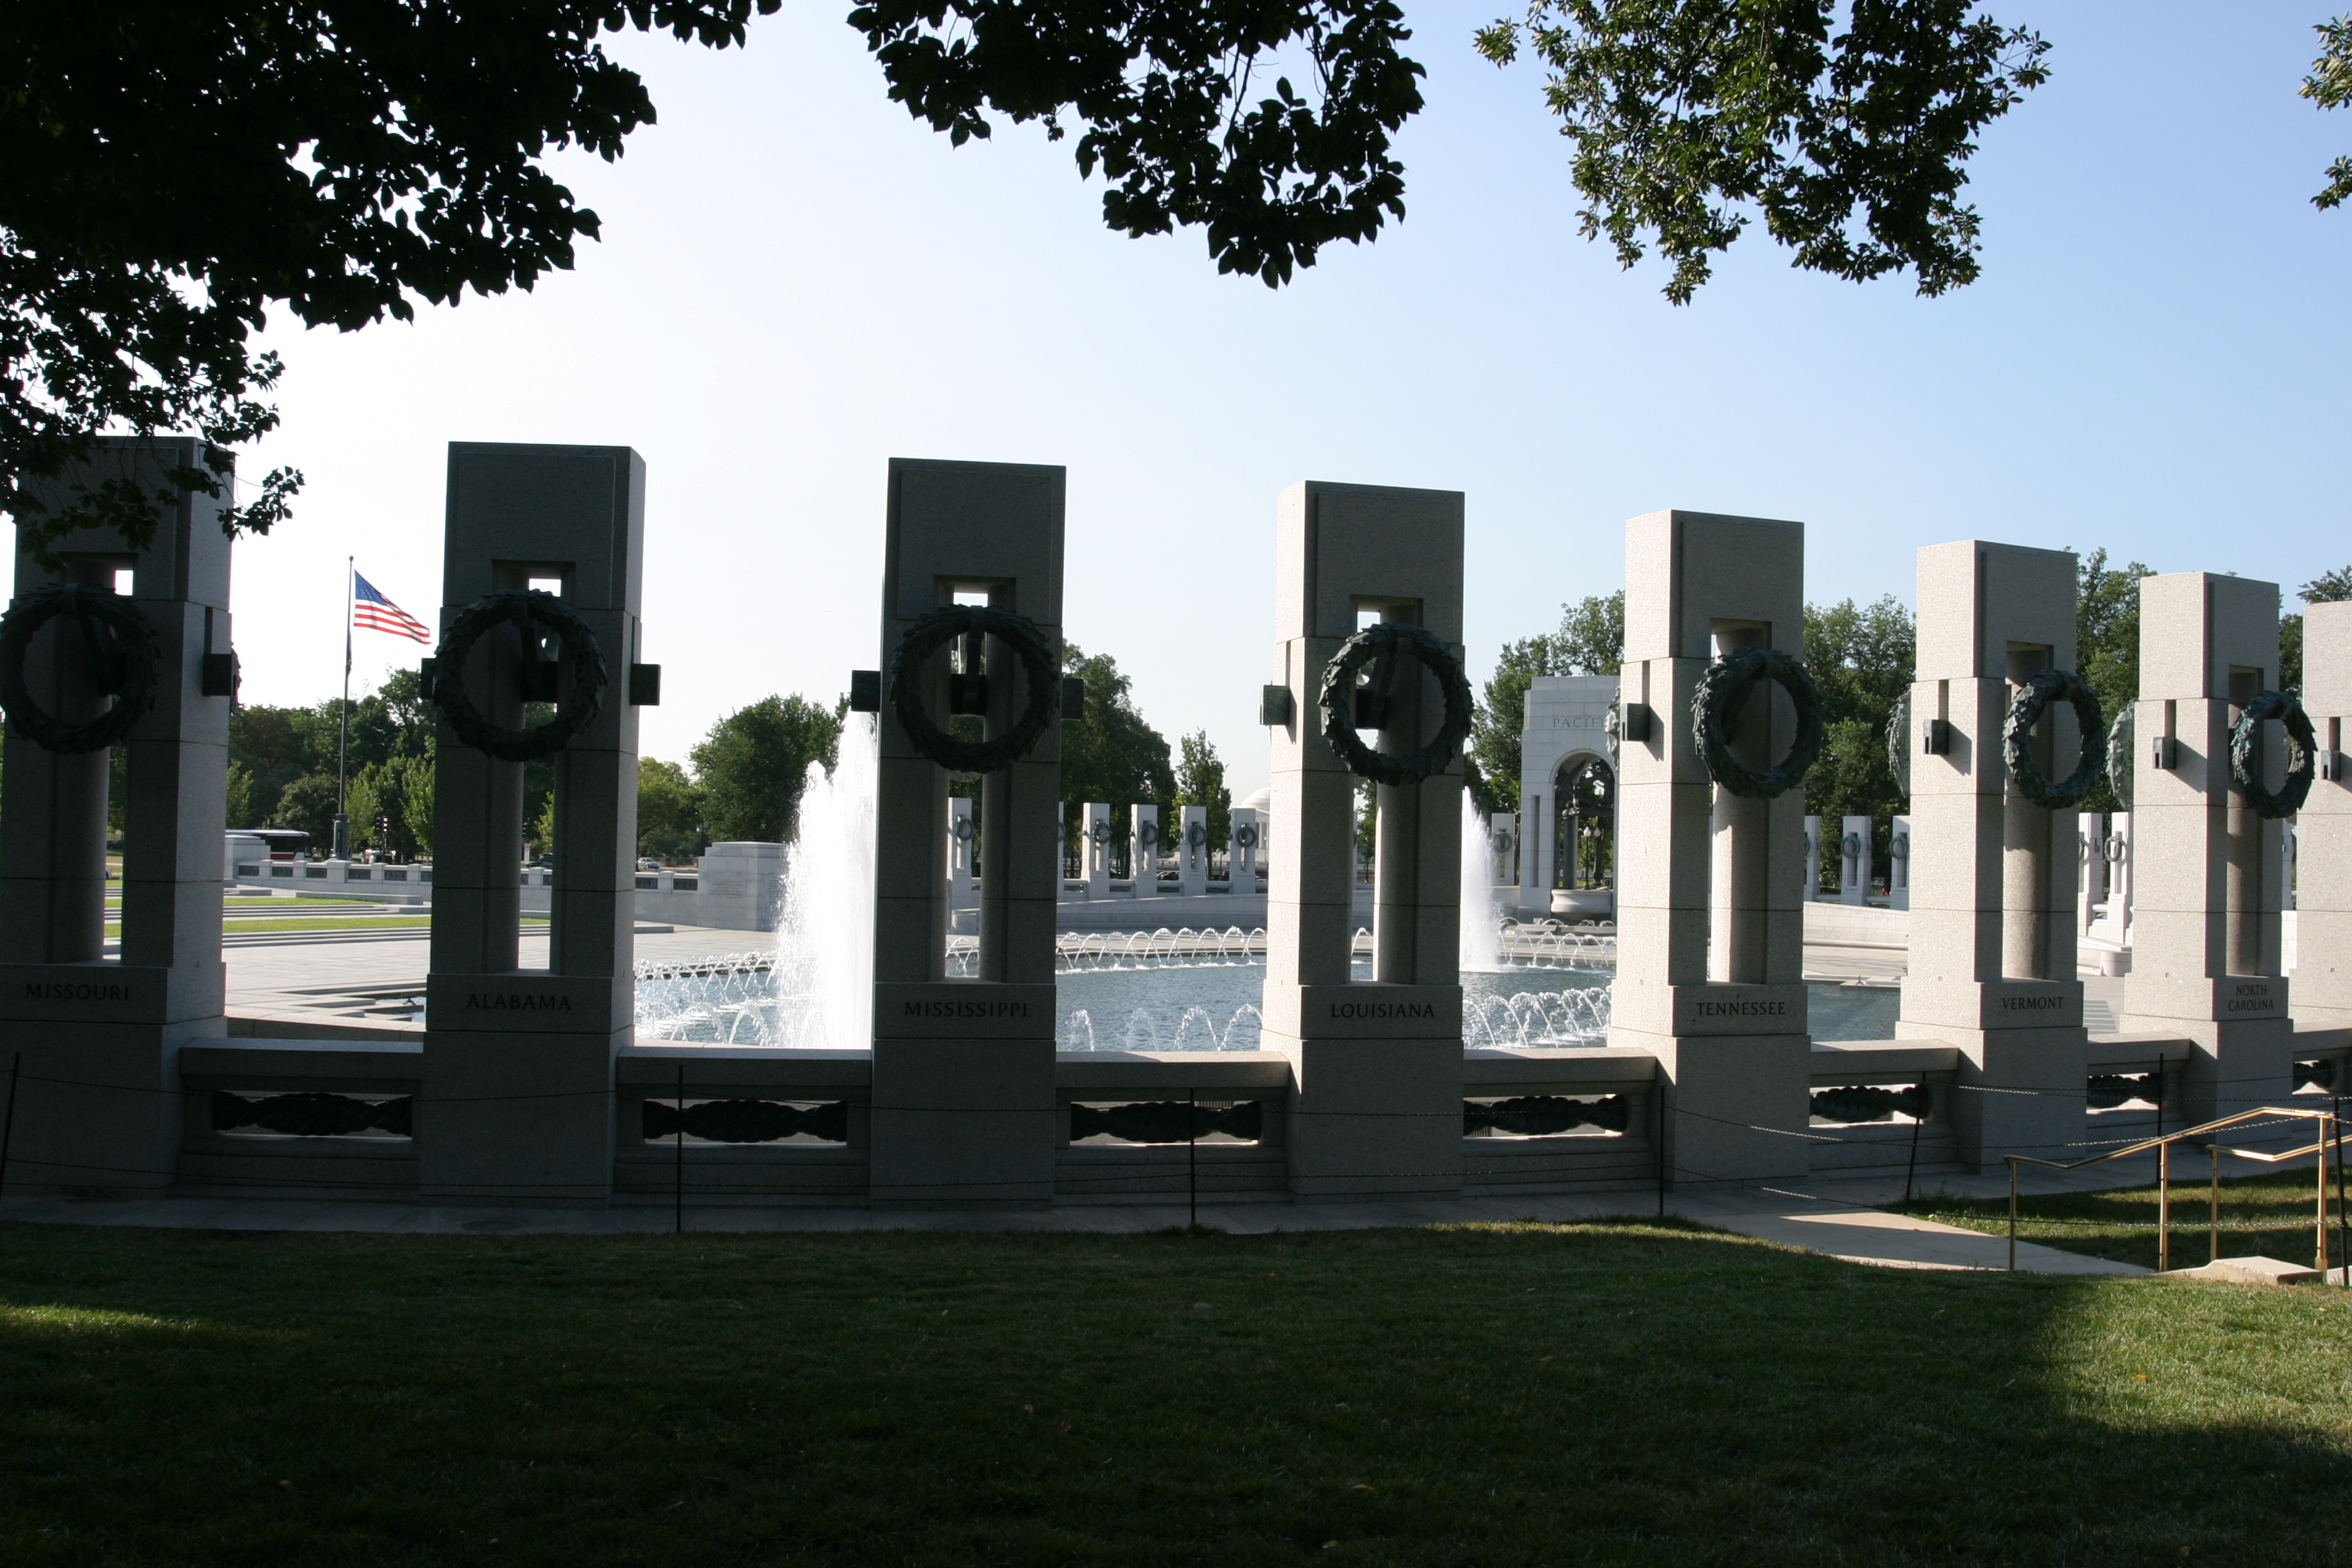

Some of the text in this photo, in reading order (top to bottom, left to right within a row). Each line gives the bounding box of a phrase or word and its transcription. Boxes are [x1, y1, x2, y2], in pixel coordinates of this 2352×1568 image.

[1553, 717, 1604, 728] PACIFI
[23, 983, 129, 1001] MISSOURI
[2236, 985, 2268, 996] NORTH
[466, 993, 572, 1011] ALABAMA
[904, 1001, 1027, 1018] MISSISSIPPI
[1696, 1001, 1785, 1016] TENNESSEE
[2001, 996, 2065, 1011] VERMONT
[2228, 999, 2275, 1012] CAROLINA
[1331, 1003, 1436, 1018] LOUISIANA
